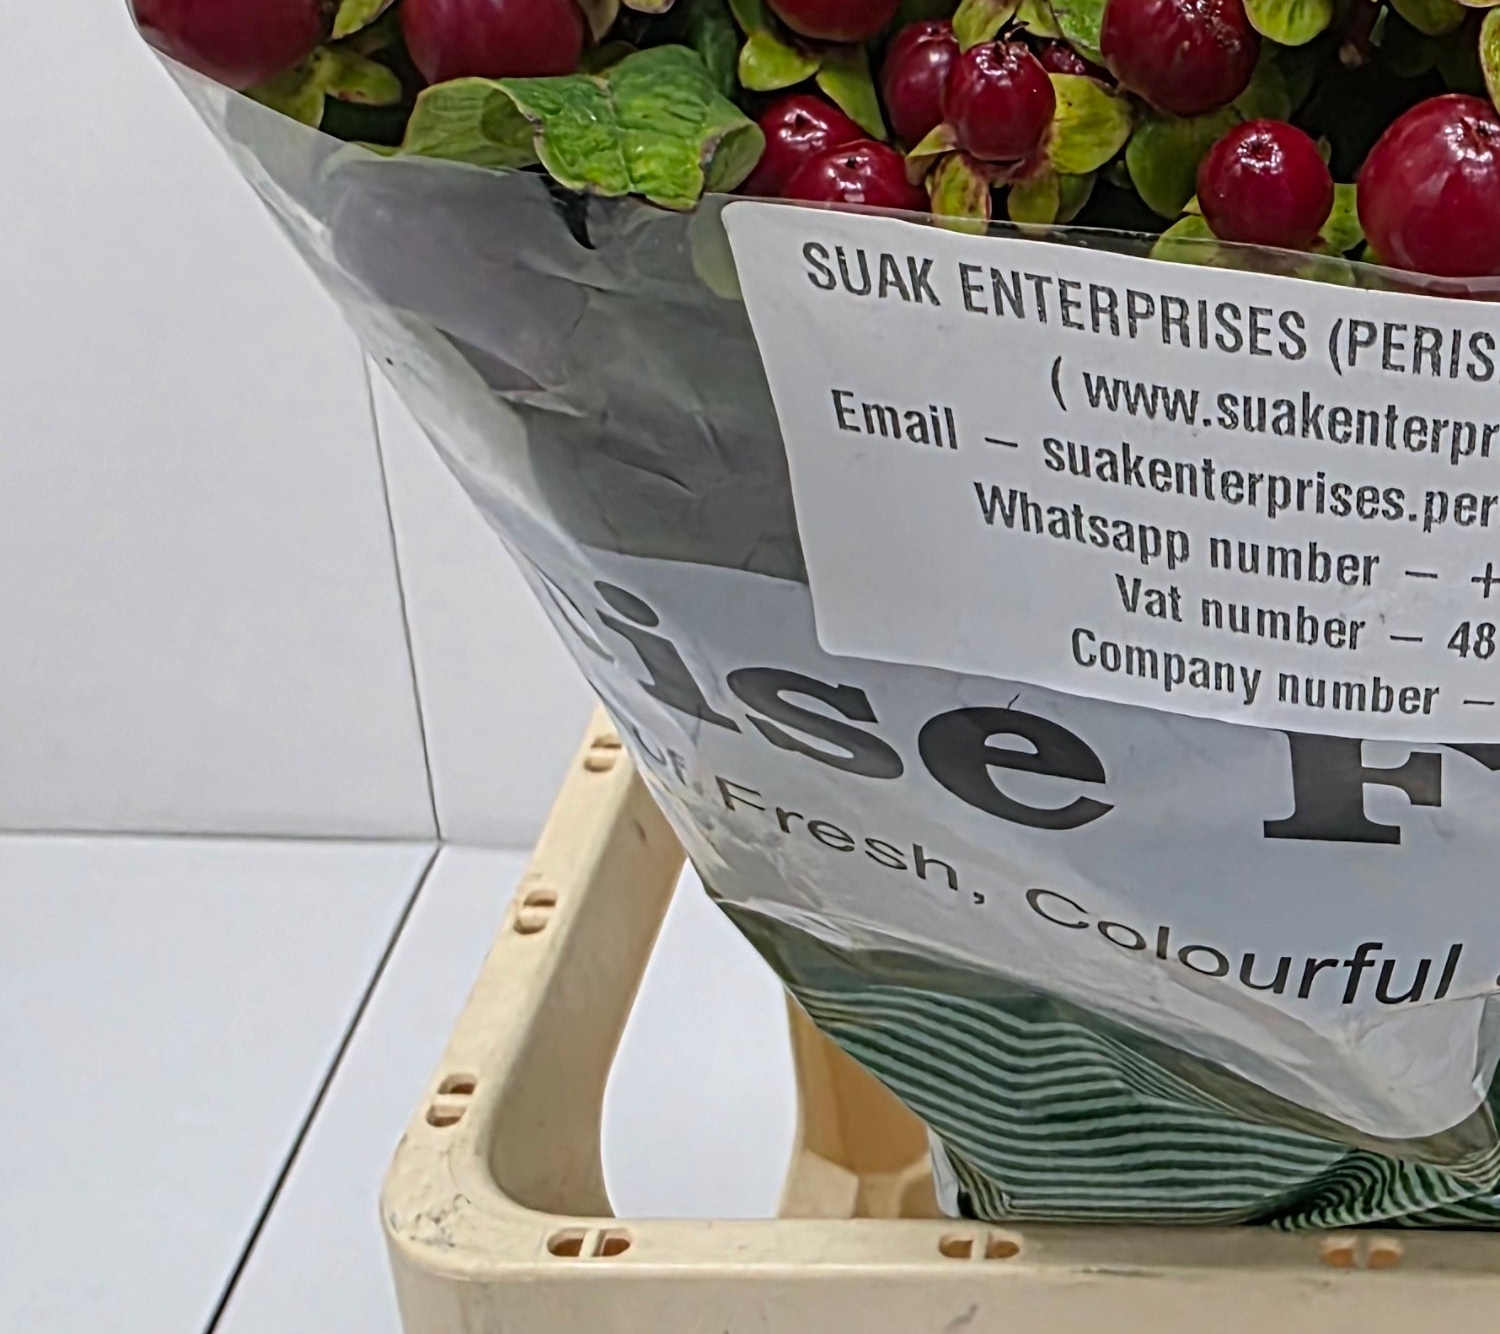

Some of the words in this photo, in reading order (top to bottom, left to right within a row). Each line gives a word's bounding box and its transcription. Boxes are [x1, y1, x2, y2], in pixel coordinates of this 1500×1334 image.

[802, 241, 941, 306] SUAK
[958, 262, 1307, 362] ENTERPRISES
[831, 389, 957, 450] Email
[973, 481, 1190, 569] Whatsapp
[1208, 535, 1380, 588] number
[1115, 574, 1183, 623] Vat
[1201, 594, 1366, 650] number
[555, 572, 1115, 830] ise
[1071, 627, 1262, 706] Company
[1278, 672, 1439, 719] number
[715, 775, 986, 905] Fresh,
[1026, 888, 1463, 1005] Colourful
